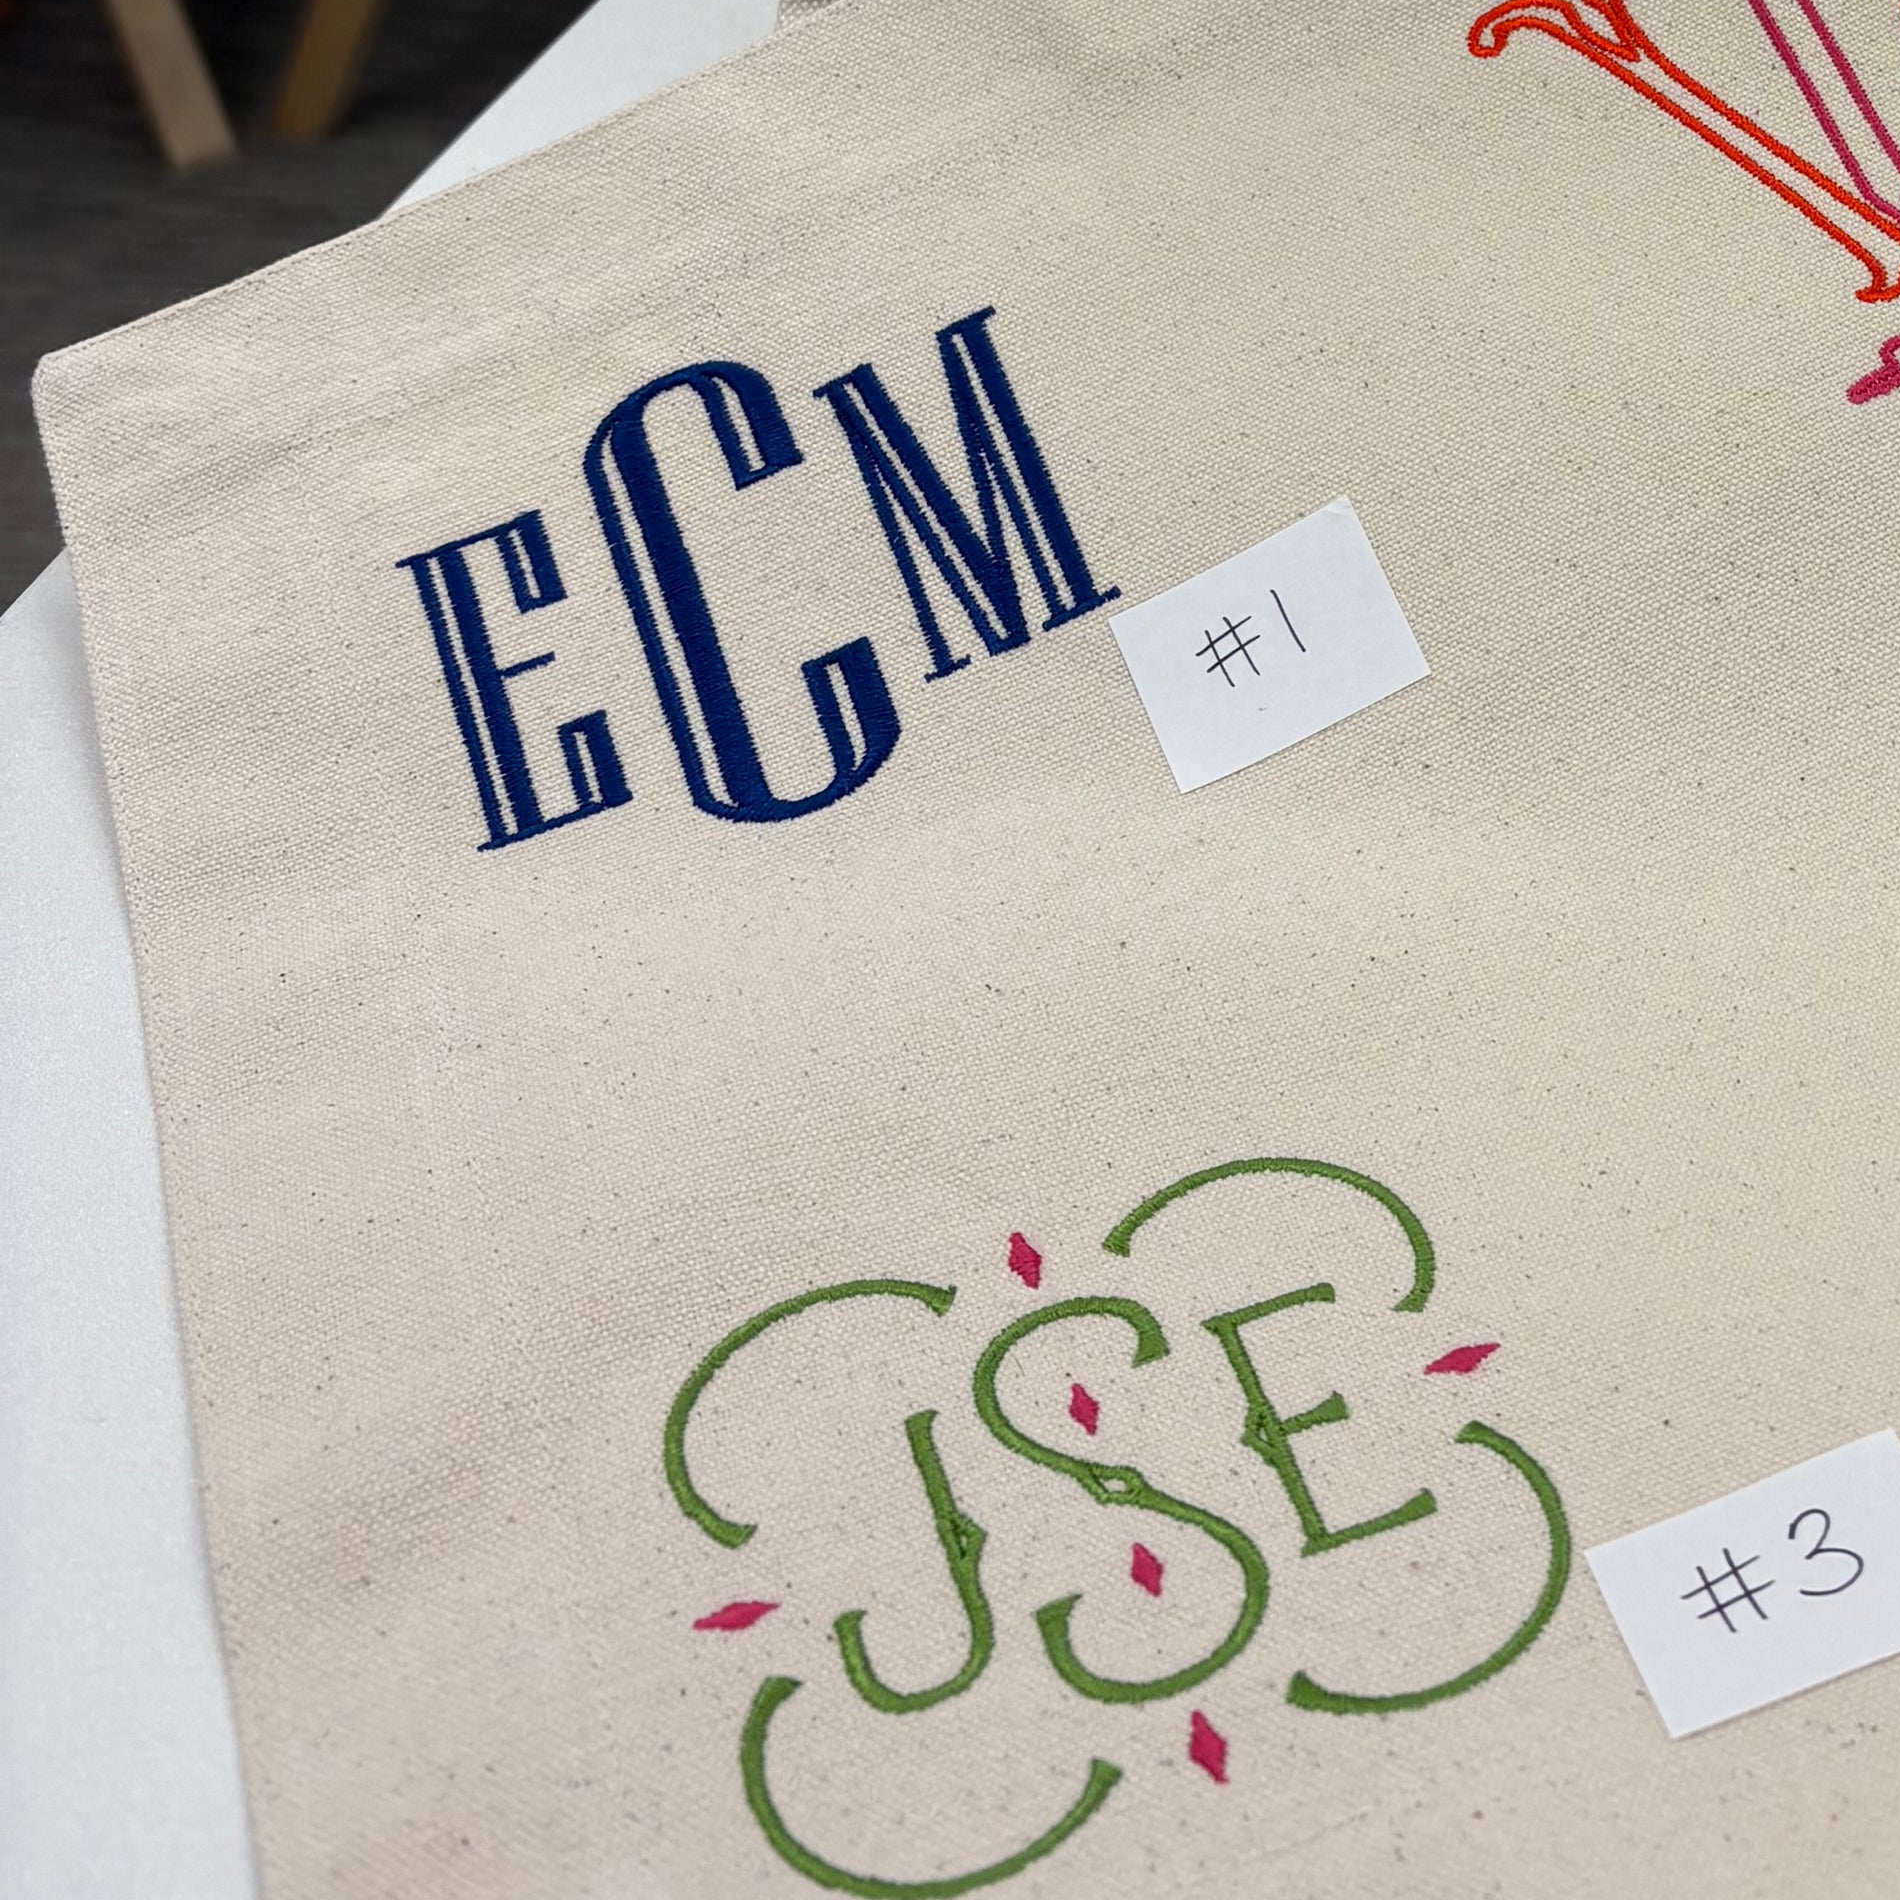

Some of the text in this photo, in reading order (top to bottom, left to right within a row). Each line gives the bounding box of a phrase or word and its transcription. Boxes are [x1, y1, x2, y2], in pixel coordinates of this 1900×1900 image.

[396, 308, 1121, 852] ECM
[1195, 589, 1305, 688] #1
[1682, 1508, 1864, 1633] #3
